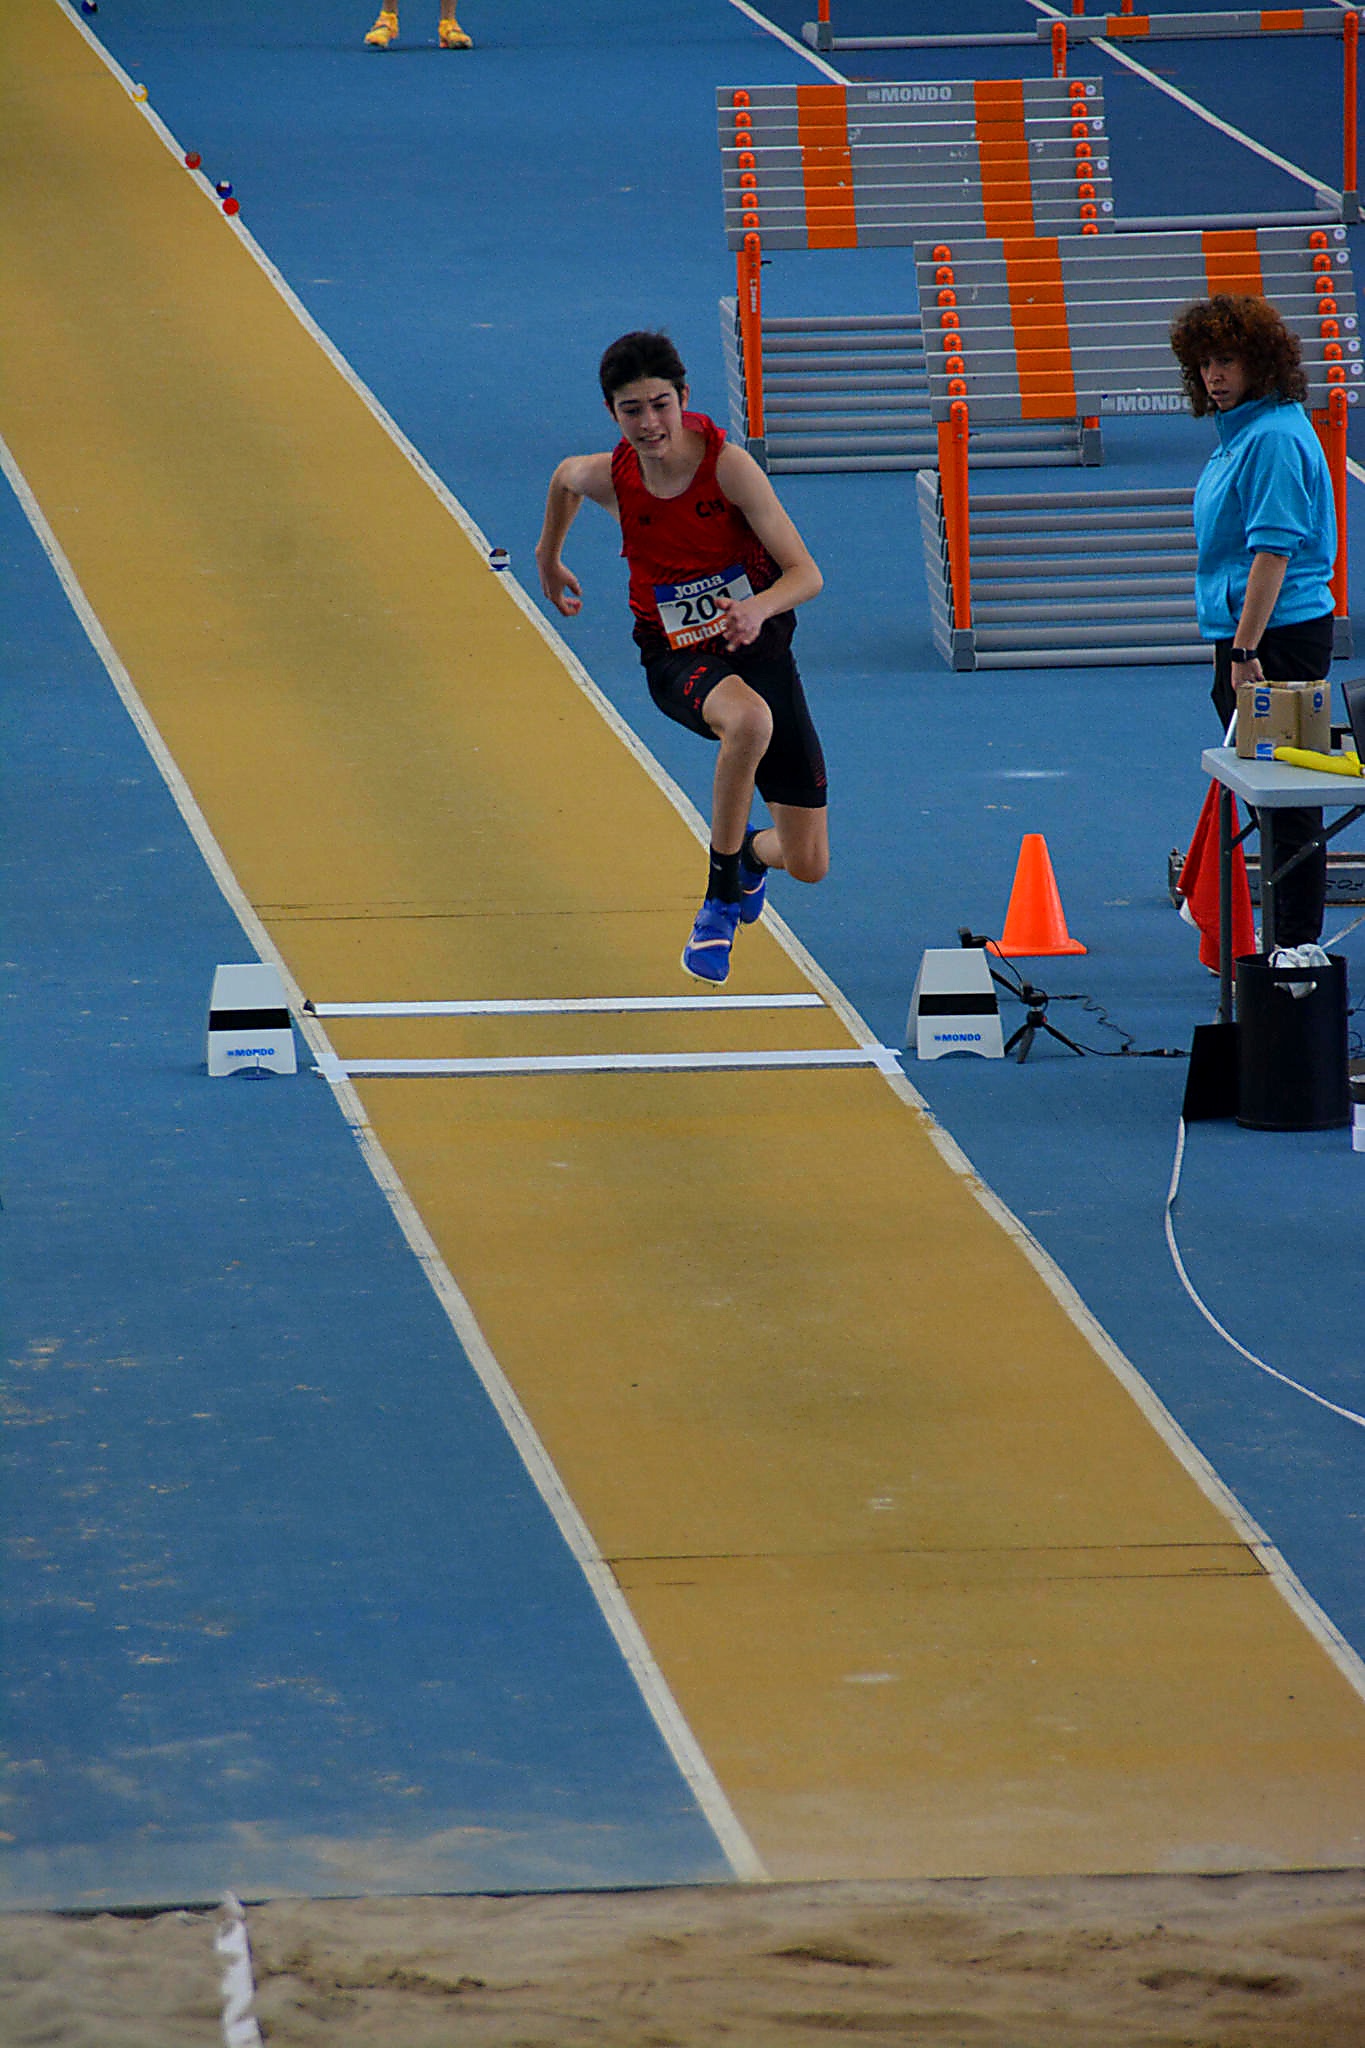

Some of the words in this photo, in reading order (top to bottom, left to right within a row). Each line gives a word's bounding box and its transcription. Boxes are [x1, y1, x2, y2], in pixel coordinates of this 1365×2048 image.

[881, 86, 952, 102] MONDO
[1117, 394, 1193, 412] MONDO
[942, 1033, 981, 1041] MONDO
[235, 1048, 275, 1057] MONDO
